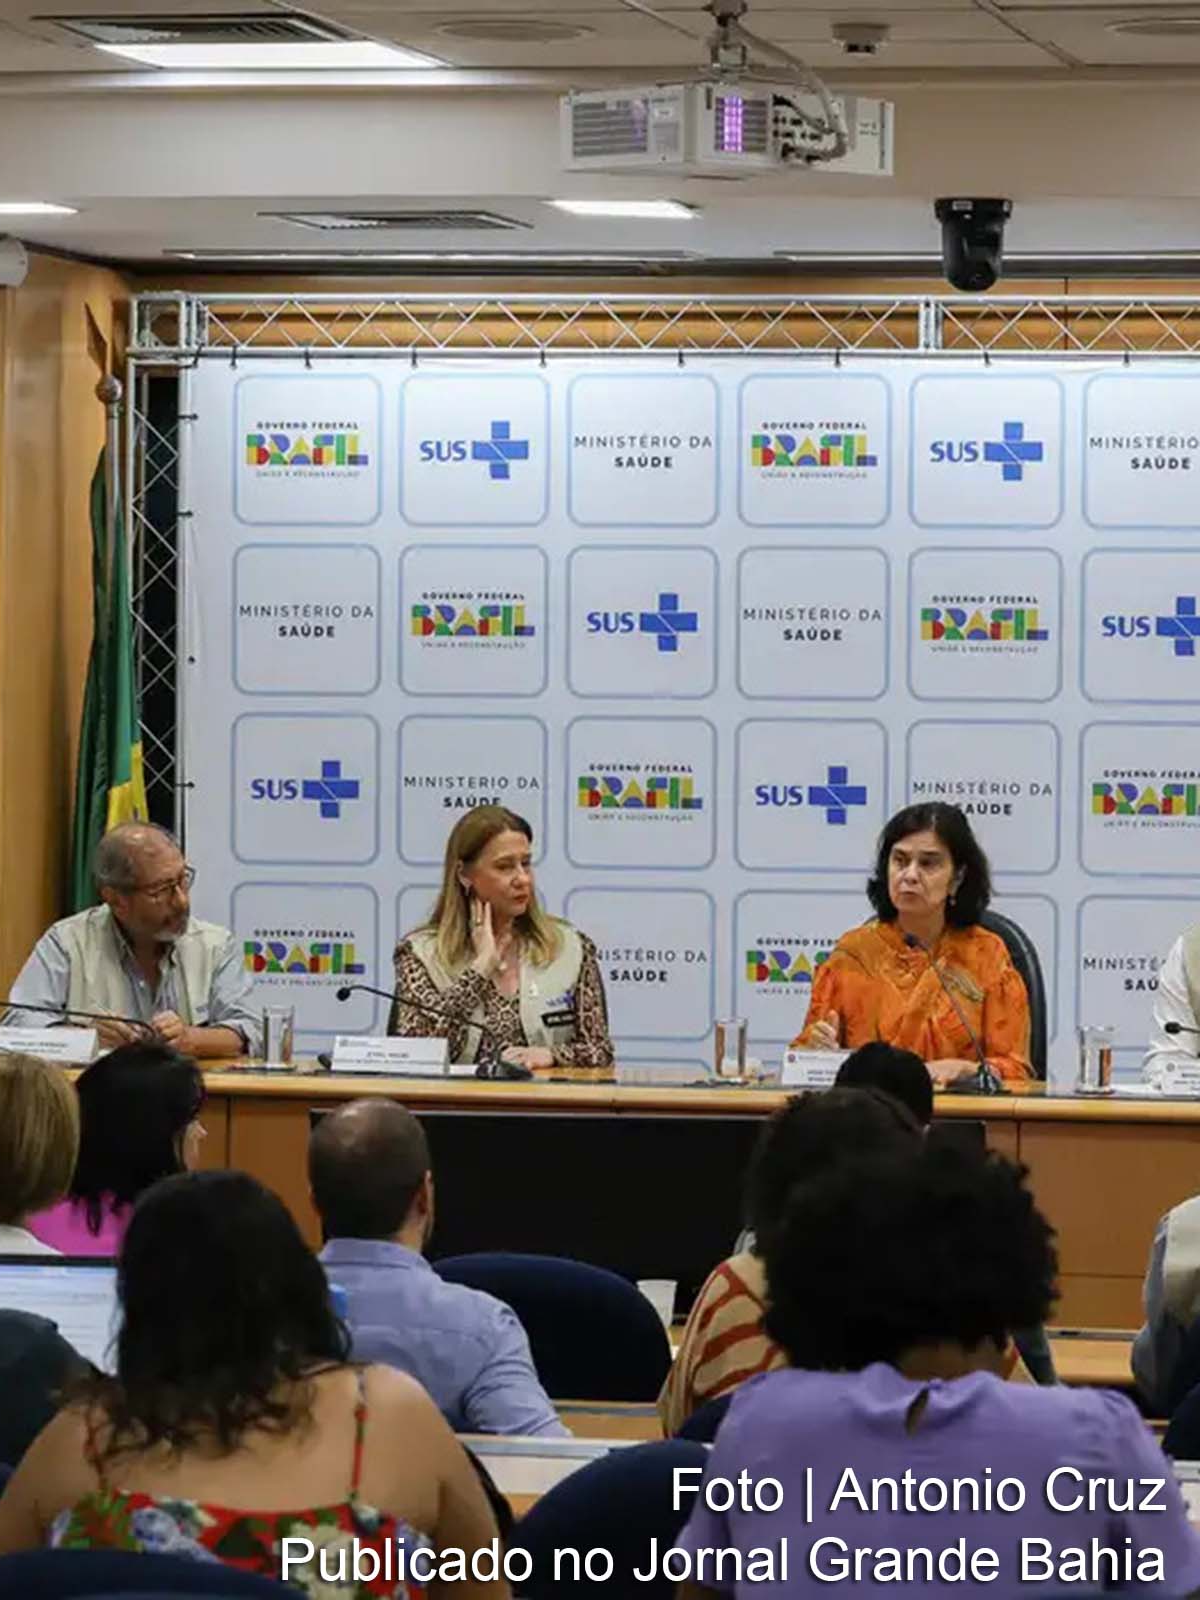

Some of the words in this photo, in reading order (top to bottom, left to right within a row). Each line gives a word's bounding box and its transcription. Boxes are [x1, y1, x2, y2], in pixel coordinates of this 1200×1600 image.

[256, 421, 309, 430] GOVERNO
[311, 422, 359, 430] FEDERAL
[762, 422, 815, 431] GOVERNO
[818, 422, 867, 431] FEDERAL
[574, 432, 682, 449] MINISTÉRIO
[689, 436, 713, 448] DA
[246, 434, 368, 466] BRASIL
[420, 440, 468, 462] SUS
[751, 434, 877, 467] BRASIL
[930, 441, 979, 463] SUS
[614, 453, 673, 469] SAÚDE
[1131, 454, 1191, 470] SAÚDE
[422, 592, 474, 600] GOVERNO
[477, 592, 526, 601] FEDERAL
[932, 595, 986, 604] GOVERNO
[989, 596, 1039, 604] FEDERAL
[239, 602, 345, 618] MINISTÉRIO
[351, 606, 375, 618] DA
[859, 608, 882, 622] DA
[411, 604, 535, 637] BRASIL
[586, 611, 635, 633] SUS
[921, 608, 1049, 641] BRASIL
[1102, 615, 1150, 637] SUS
[278, 622, 336, 638] SAÚDE
[783, 626, 843, 641] SAÚDE
[589, 763, 641, 772] GOVERNO
[644, 765, 693, 773] FEDERAL
[1103, 769, 1157, 778] GOVERNO
[251, 778, 298, 800] SUS
[517, 777, 540, 789] DA
[1029, 783, 1053, 796] DA
[577, 776, 703, 810] BRASIL
[756, 785, 803, 807] SUS
[254, 929, 304, 938] GOVERNO
[756, 937, 810, 946] GOVERNO
[243, 941, 365, 975] BRASIL
[684, 950, 707, 962] DA
[610, 966, 668, 982] SAÚDE
[1124, 976, 1160, 991] SAÚ
